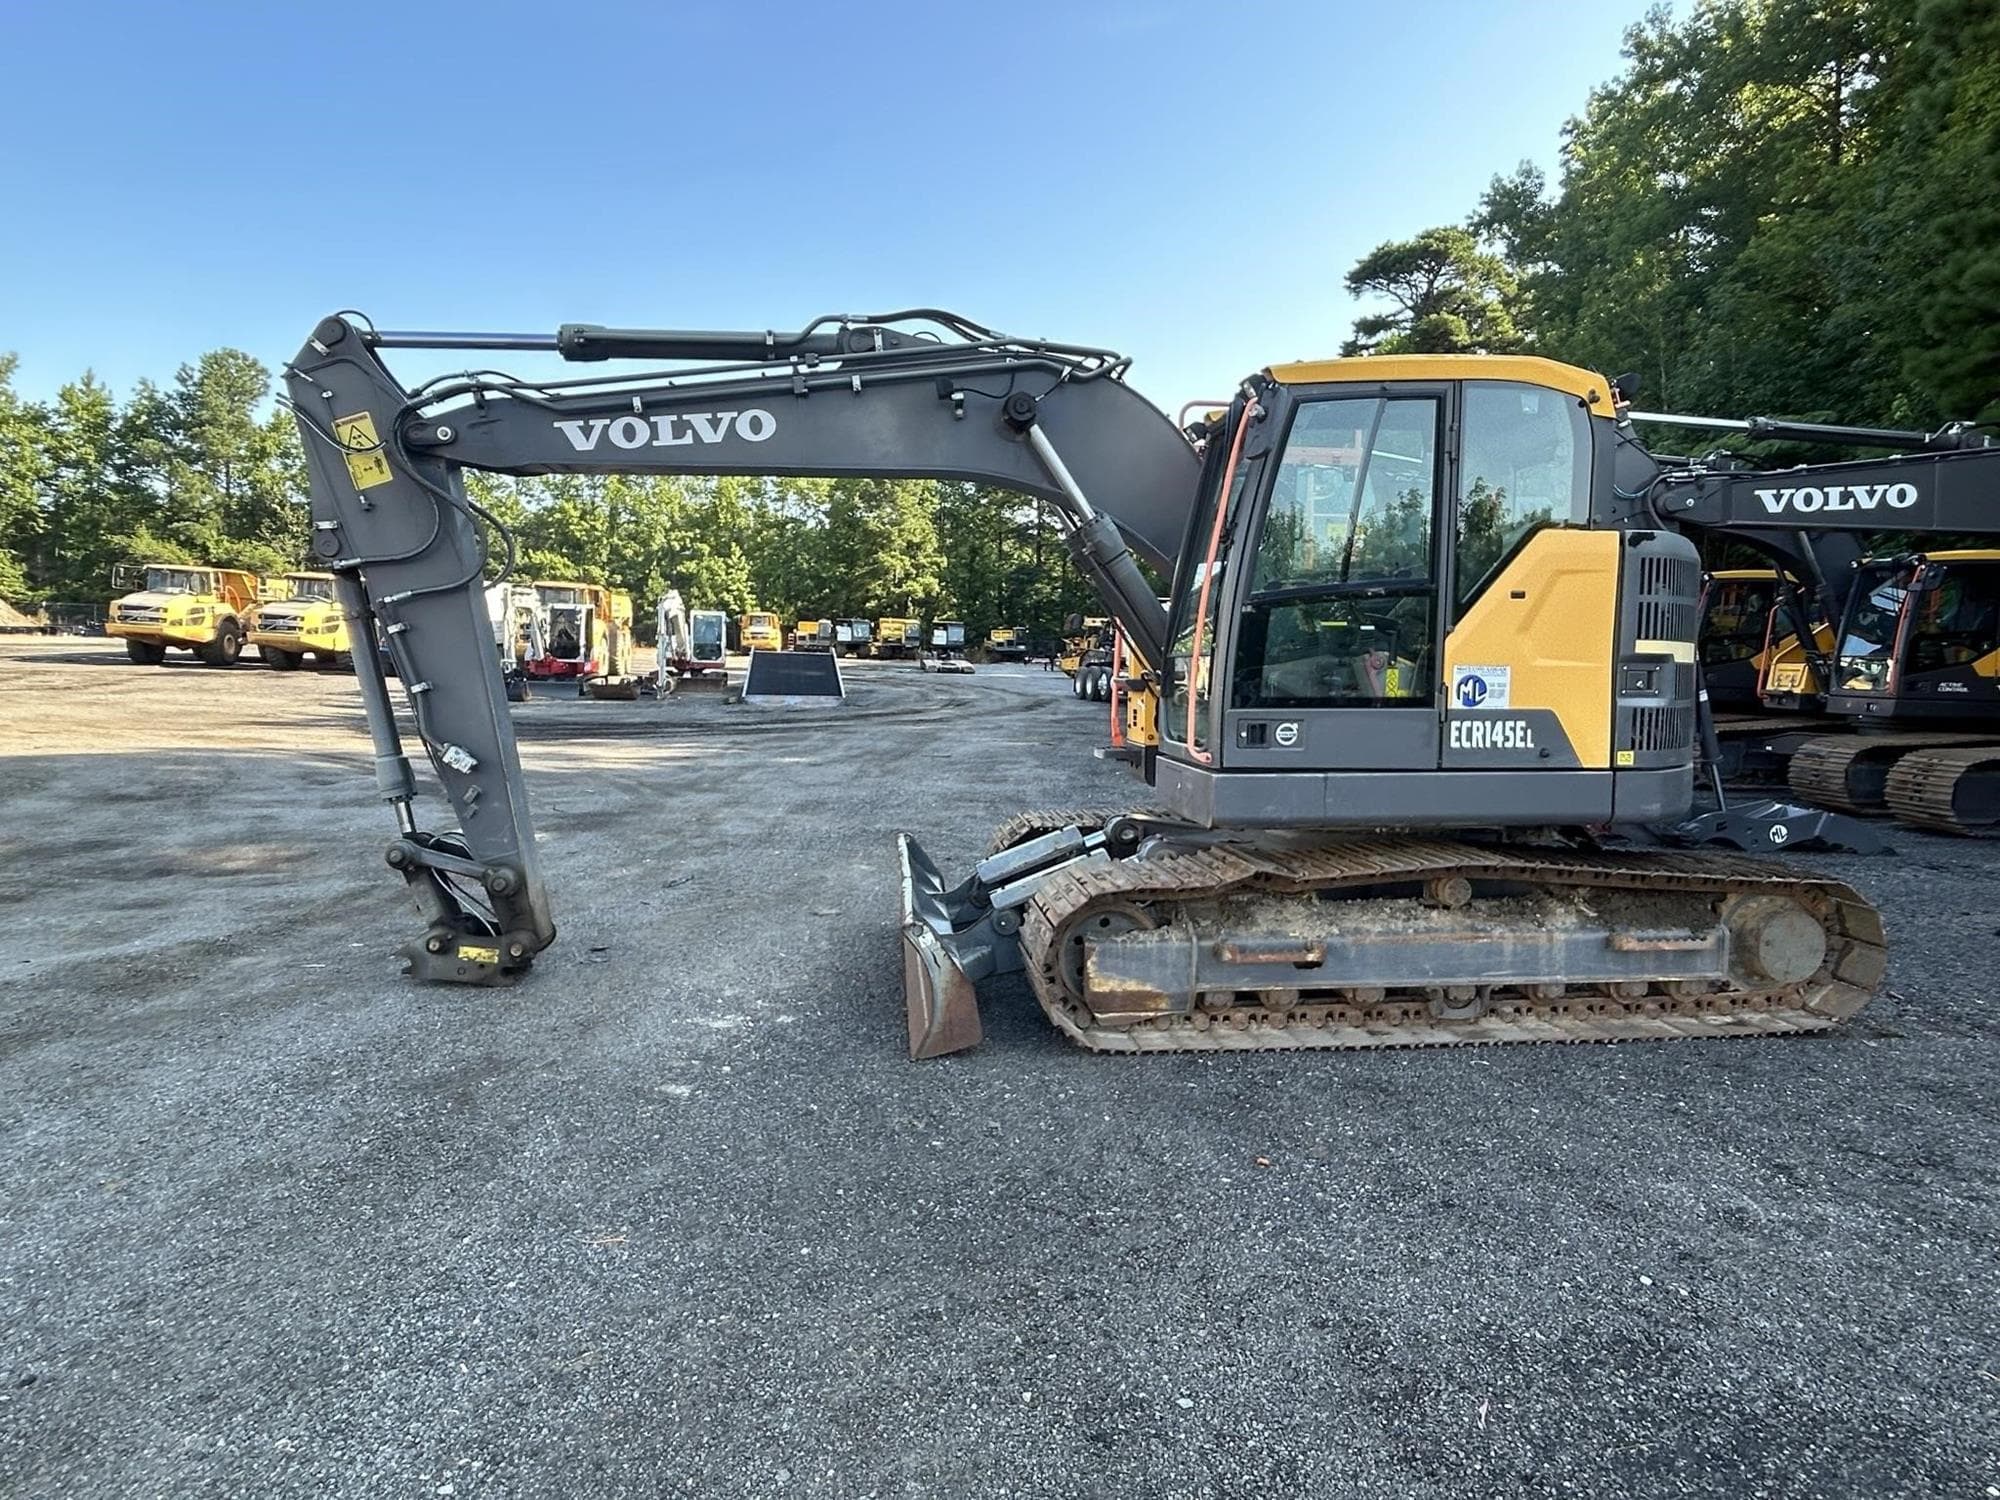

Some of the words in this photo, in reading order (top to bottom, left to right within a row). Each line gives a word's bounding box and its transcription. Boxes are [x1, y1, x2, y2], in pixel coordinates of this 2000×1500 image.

[553, 408, 777, 451] VOLVO
[1754, 483, 1918, 513] VOLVO
[1457, 677, 1487, 706] ML
